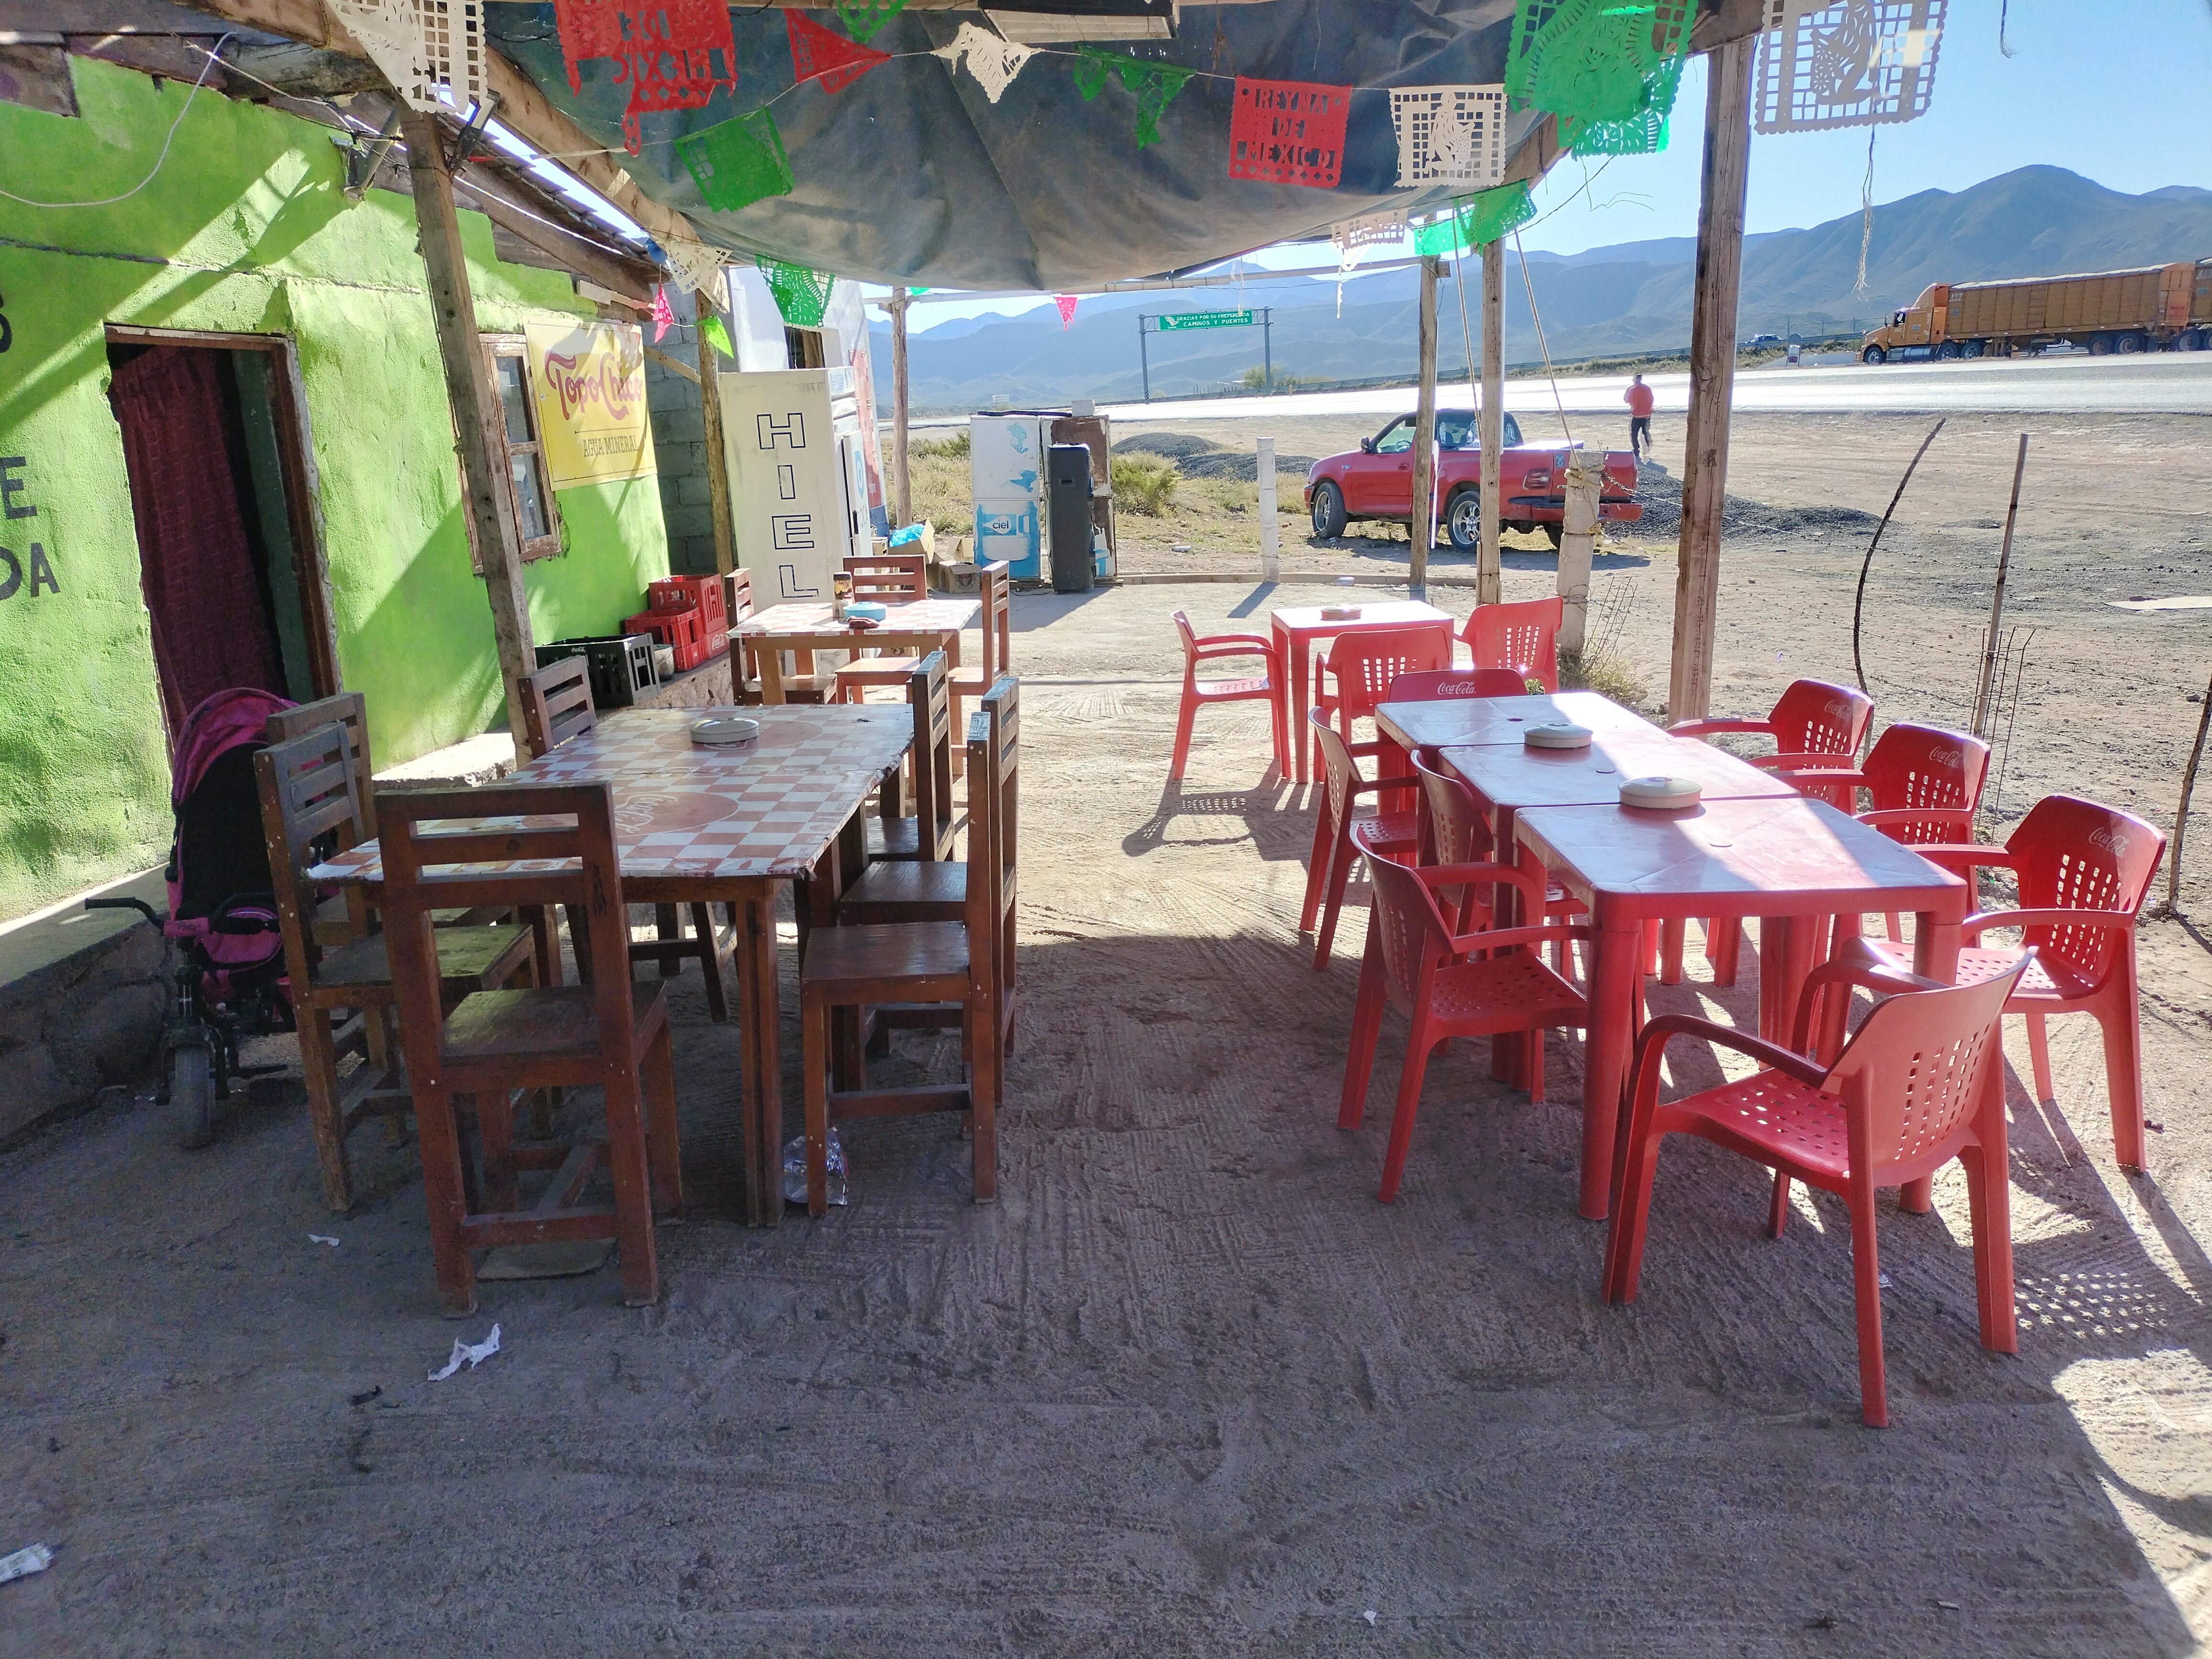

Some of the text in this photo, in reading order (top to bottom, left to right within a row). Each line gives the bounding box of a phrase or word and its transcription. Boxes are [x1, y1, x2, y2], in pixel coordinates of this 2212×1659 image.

[1259, 88, 1324, 115] REYNA
[1277, 118, 1305, 139] DE
[1246, 141, 1330, 169] MEXICO
[1949, 293, 1963, 302] ALT
[544, 348, 642, 421] Topo Chico
[583, 435, 639, 457] AGUA MINERAL
[993, 520, 1009, 529] ciel
[1438, 681, 1476, 695] Coca-Cola
[2089, 827, 2130, 859] Coca-Cola
